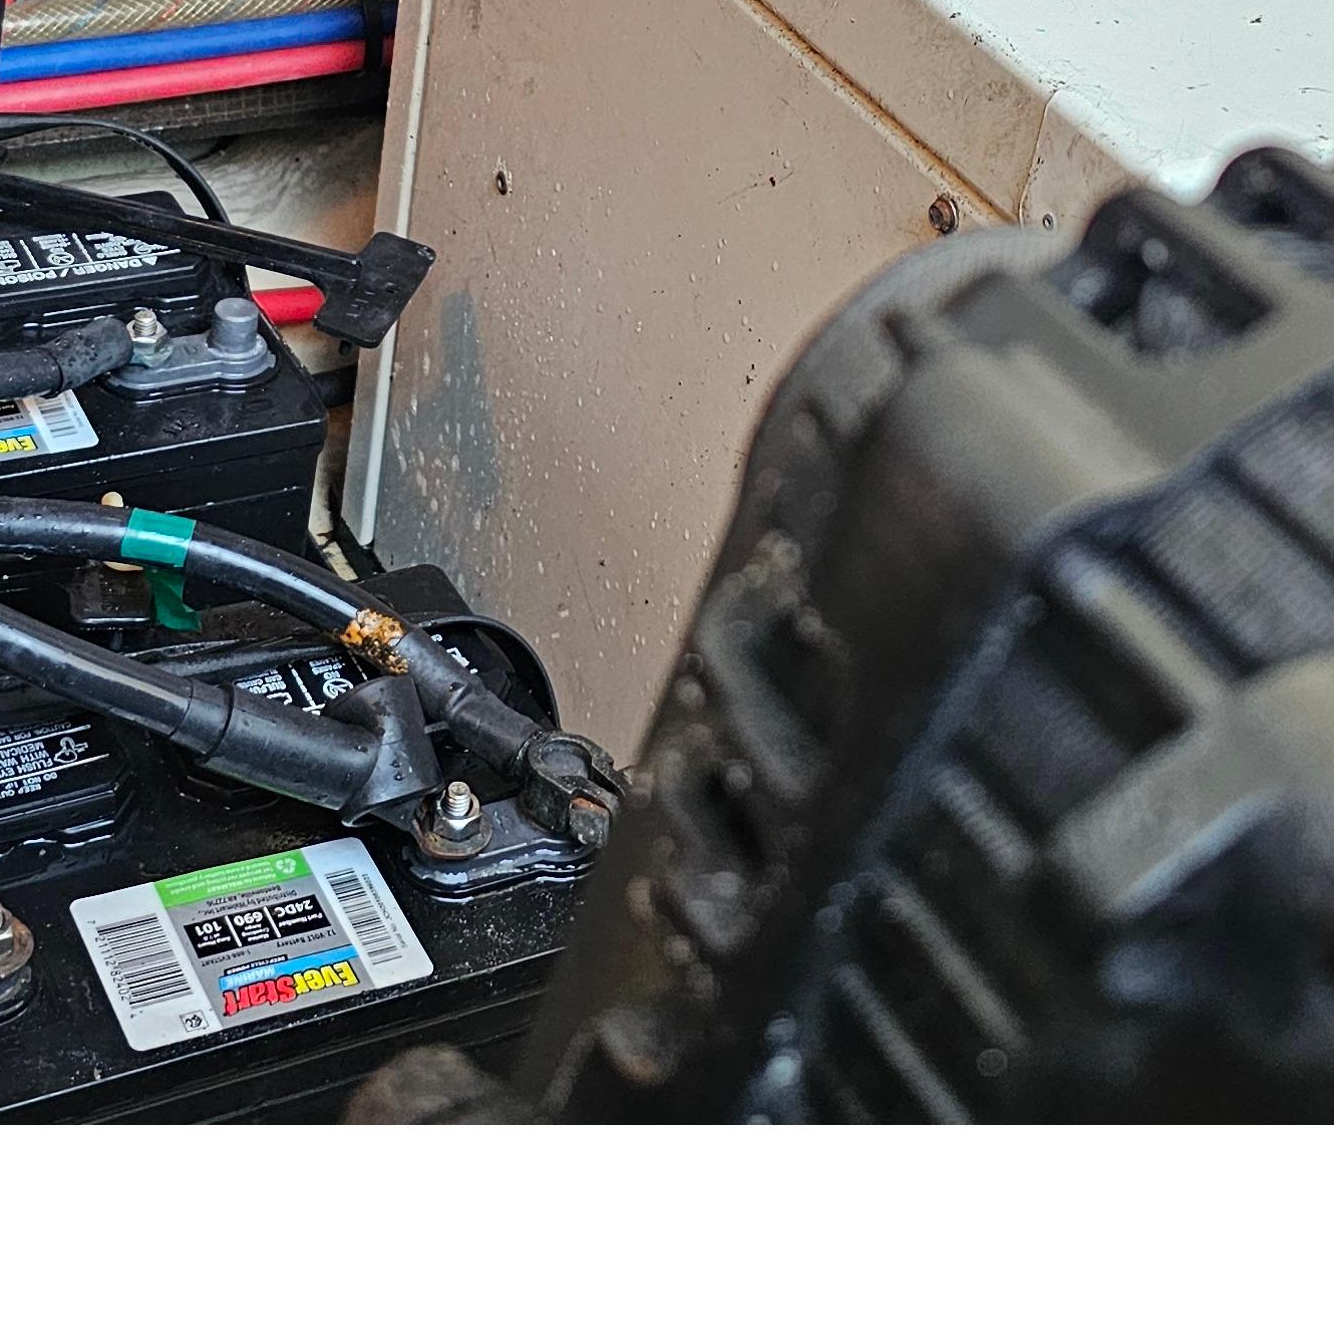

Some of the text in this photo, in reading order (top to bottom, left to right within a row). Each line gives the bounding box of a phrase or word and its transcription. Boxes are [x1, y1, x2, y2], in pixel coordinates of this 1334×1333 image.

[72, 257, 142, 275] DANGER
[19, 748, 49, 763] WITH
[14, 757, 51, 773] FLUSH
[21, 775, 41, 786] NOT
[254, 887, 297, 904] Distributed
[213, 899, 246, 913] Walmart
[273, 897, 313, 918] 24DC
[231, 908, 263, 926] 690
[277, 910, 323, 928] Part Number
[192, 917, 222, 937] 101
[275, 933, 305, 949] Battery
[93, 934, 132, 1002] 21112 82402
[224, 965, 275, 988] MARINE
[225, 963, 250, 974] POWER
[220, 958, 359, 1017] EverStart
